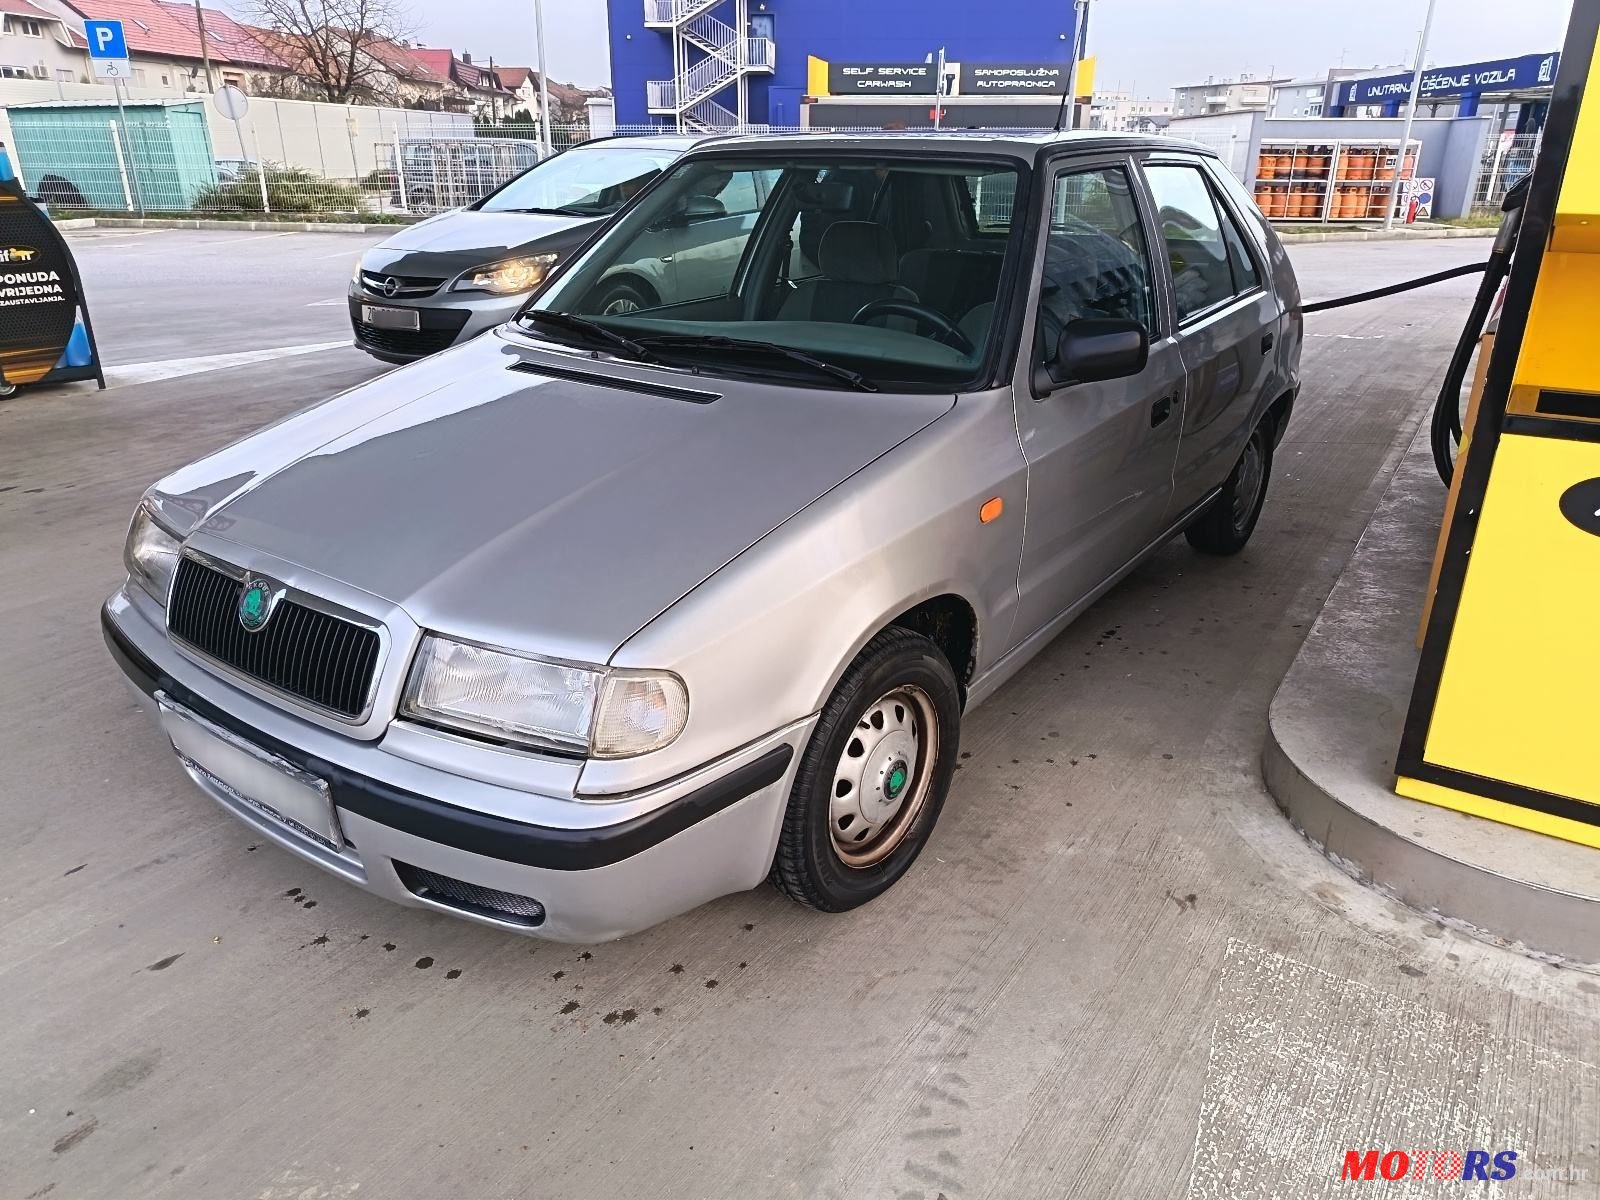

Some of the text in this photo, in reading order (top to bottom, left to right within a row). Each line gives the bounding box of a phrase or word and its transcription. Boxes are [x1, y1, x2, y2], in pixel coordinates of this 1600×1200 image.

[95, 27, 114, 52] P
[842, 67, 927, 76] SELF SERVICE
[974, 67, 1060, 77] SAMOPOSLUŽNA
[857, 80, 912, 88] CARWASH
[976, 80, 1056, 88] AUTOPRAONICA
[1367, 82, 1413, 97] UNUTARNJ
[1474, 68, 1516, 85] VOZILA
